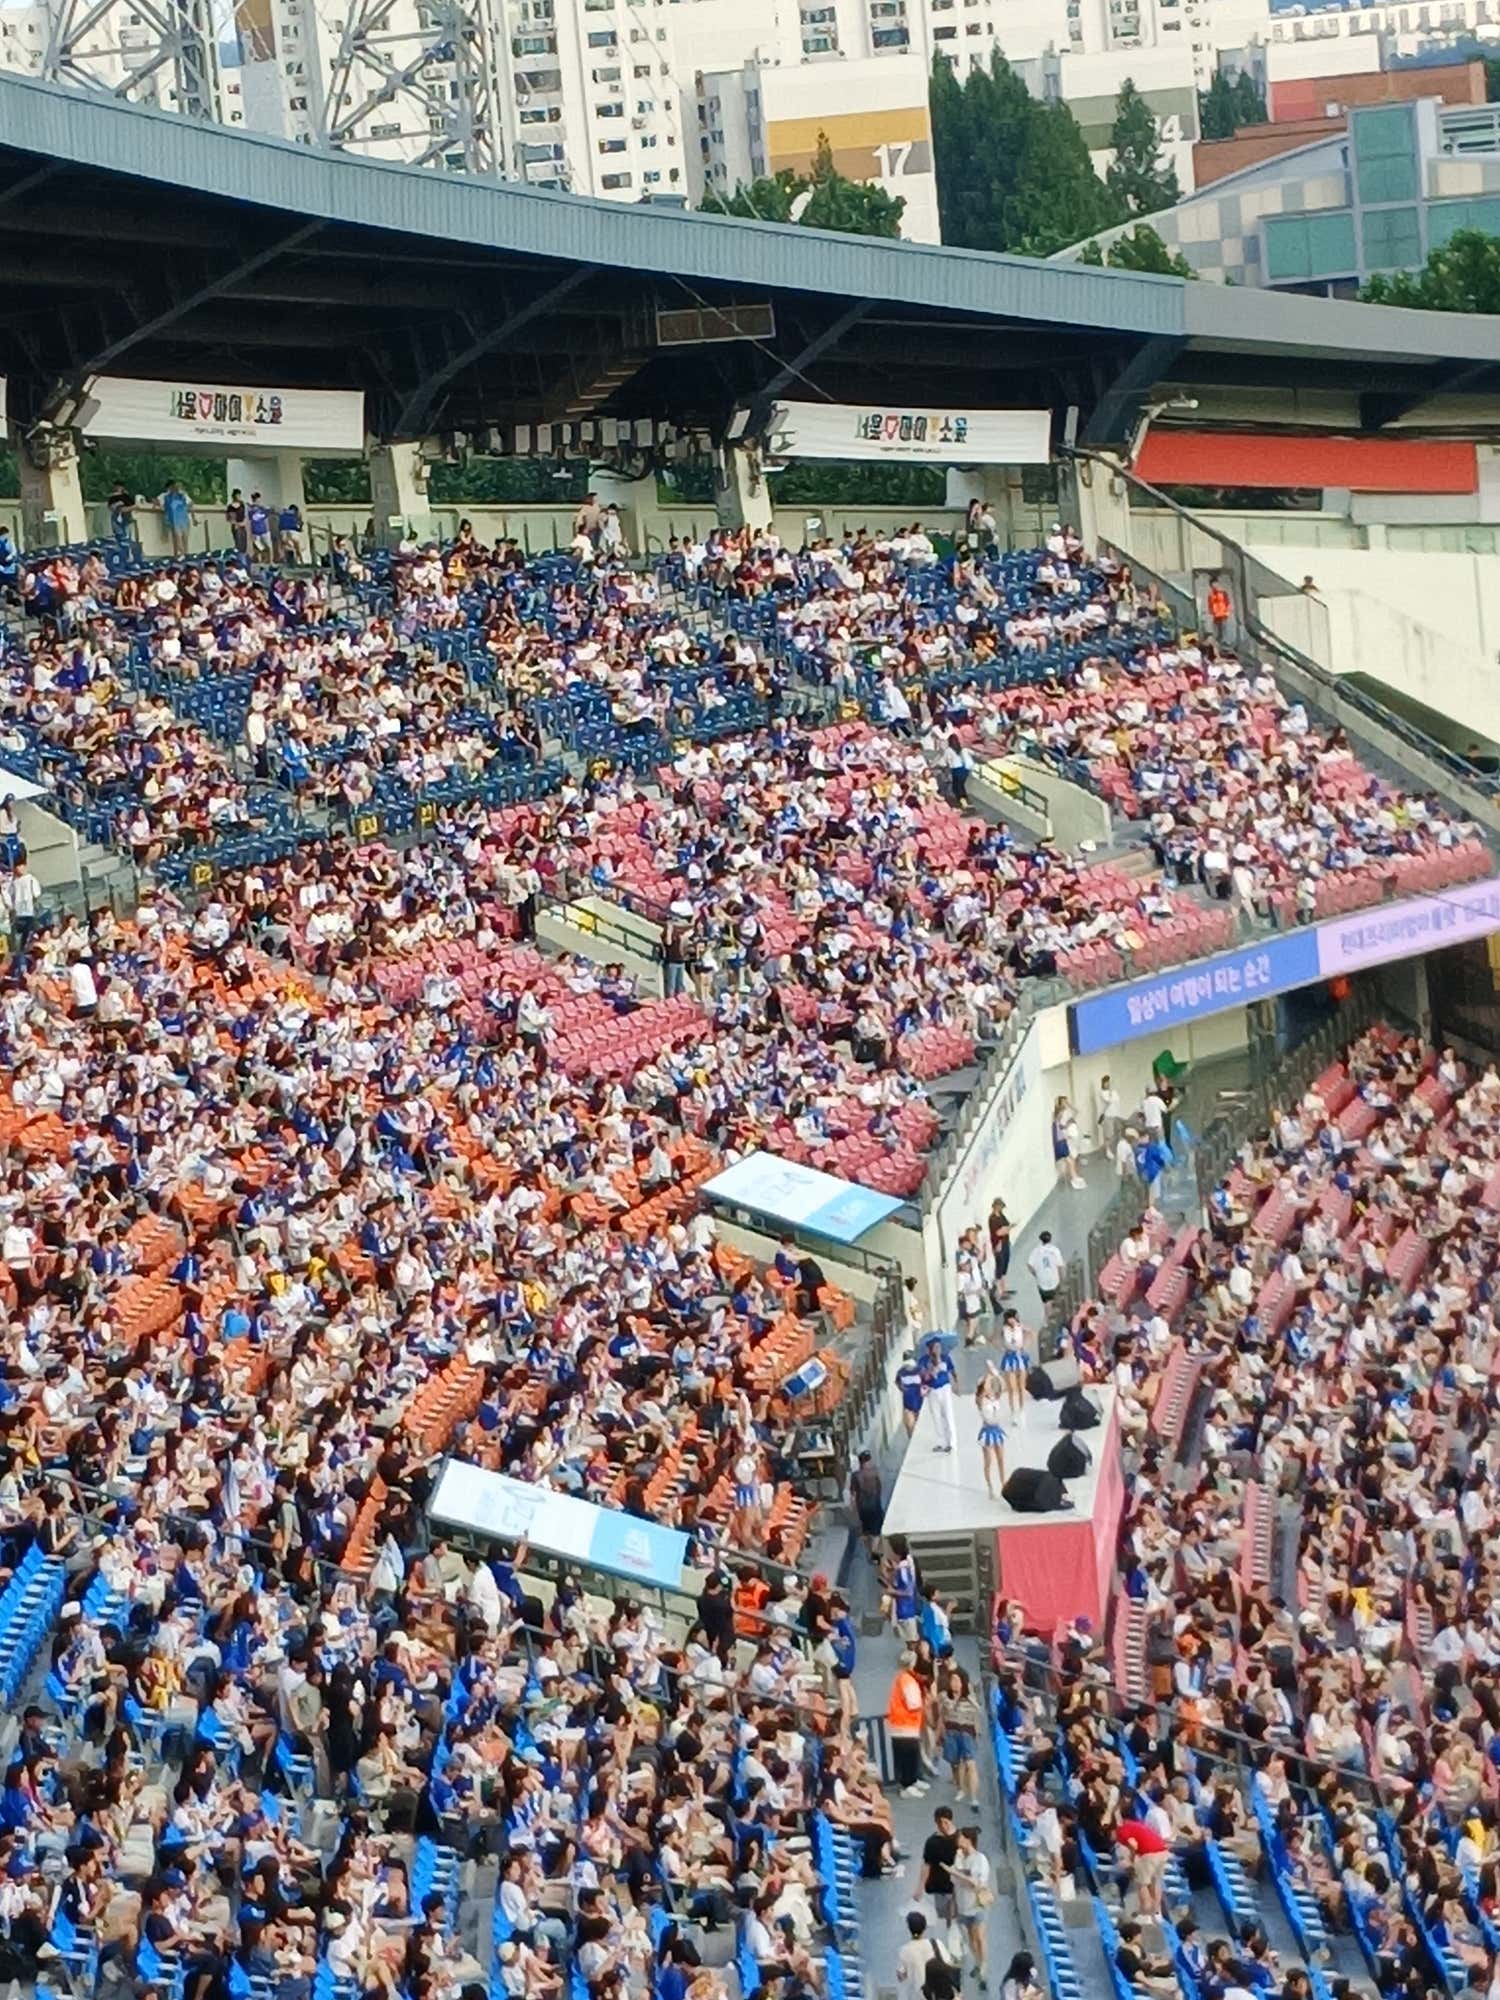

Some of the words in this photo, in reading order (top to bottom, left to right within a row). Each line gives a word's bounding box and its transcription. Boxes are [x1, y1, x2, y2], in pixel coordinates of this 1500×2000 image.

[872, 141, 912, 178] 17
[1127, 985, 1169, 1025] 일상이
[1170, 972, 1213, 1008] 여행이
[1214, 966, 1242, 993] 되는
[1243, 954, 1271, 988] 순간
